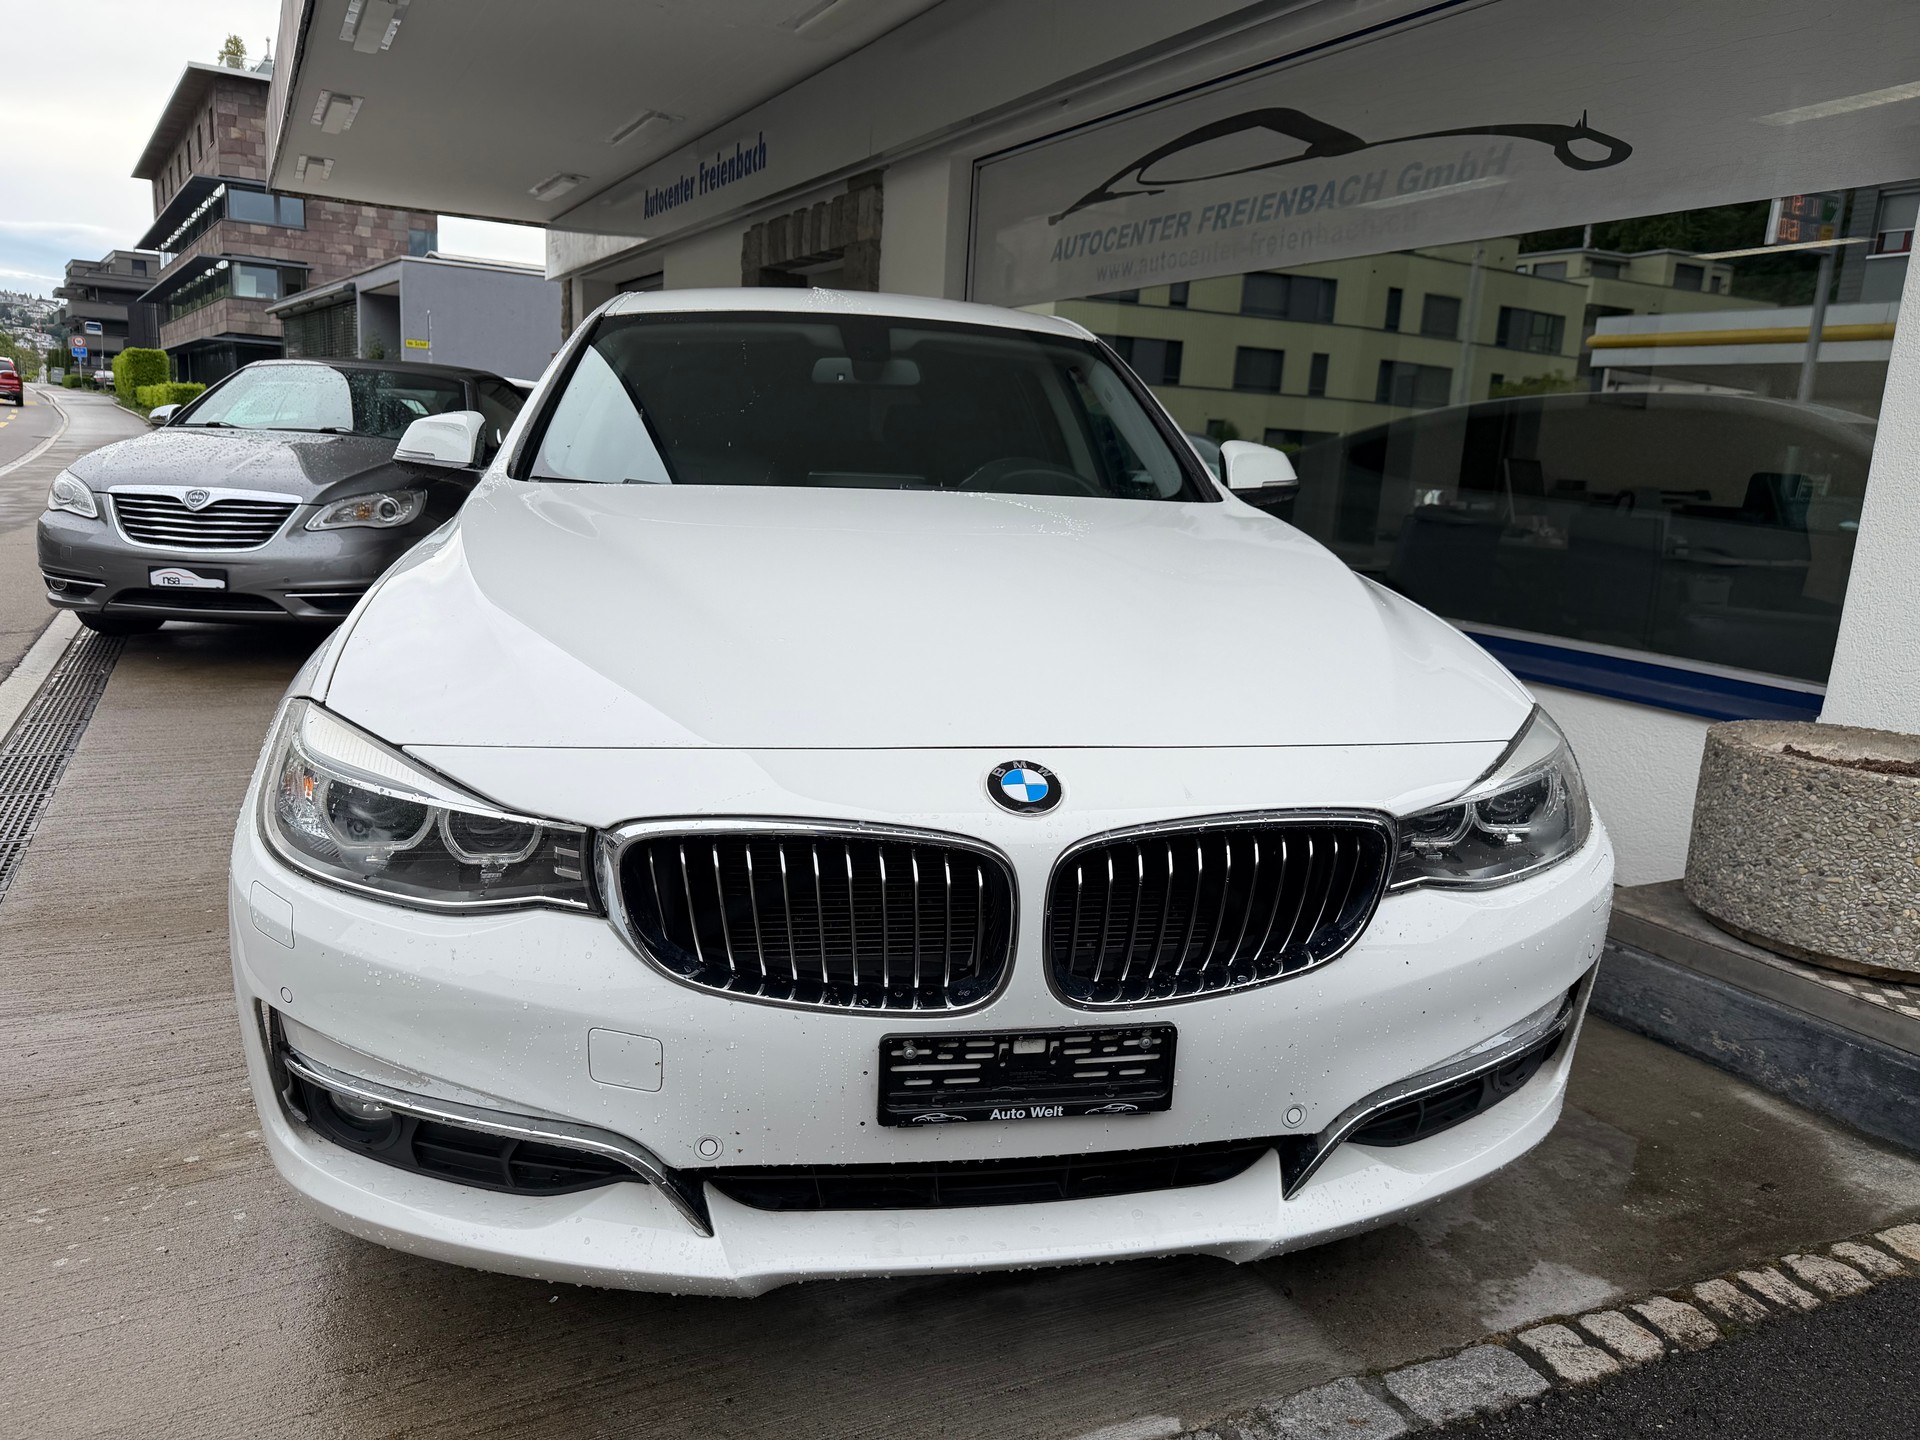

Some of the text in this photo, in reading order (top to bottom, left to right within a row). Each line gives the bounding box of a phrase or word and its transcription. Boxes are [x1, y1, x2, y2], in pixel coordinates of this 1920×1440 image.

[644, 131, 767, 220] Autocenter Freienbach
[1050, 142, 1515, 263] AUTOCENTER FREIENBACH GmbH
[162, 576, 181, 585] nsa
[992, 761, 1053, 778] BMW
[990, 1105, 1064, 1120] Auto Welt
